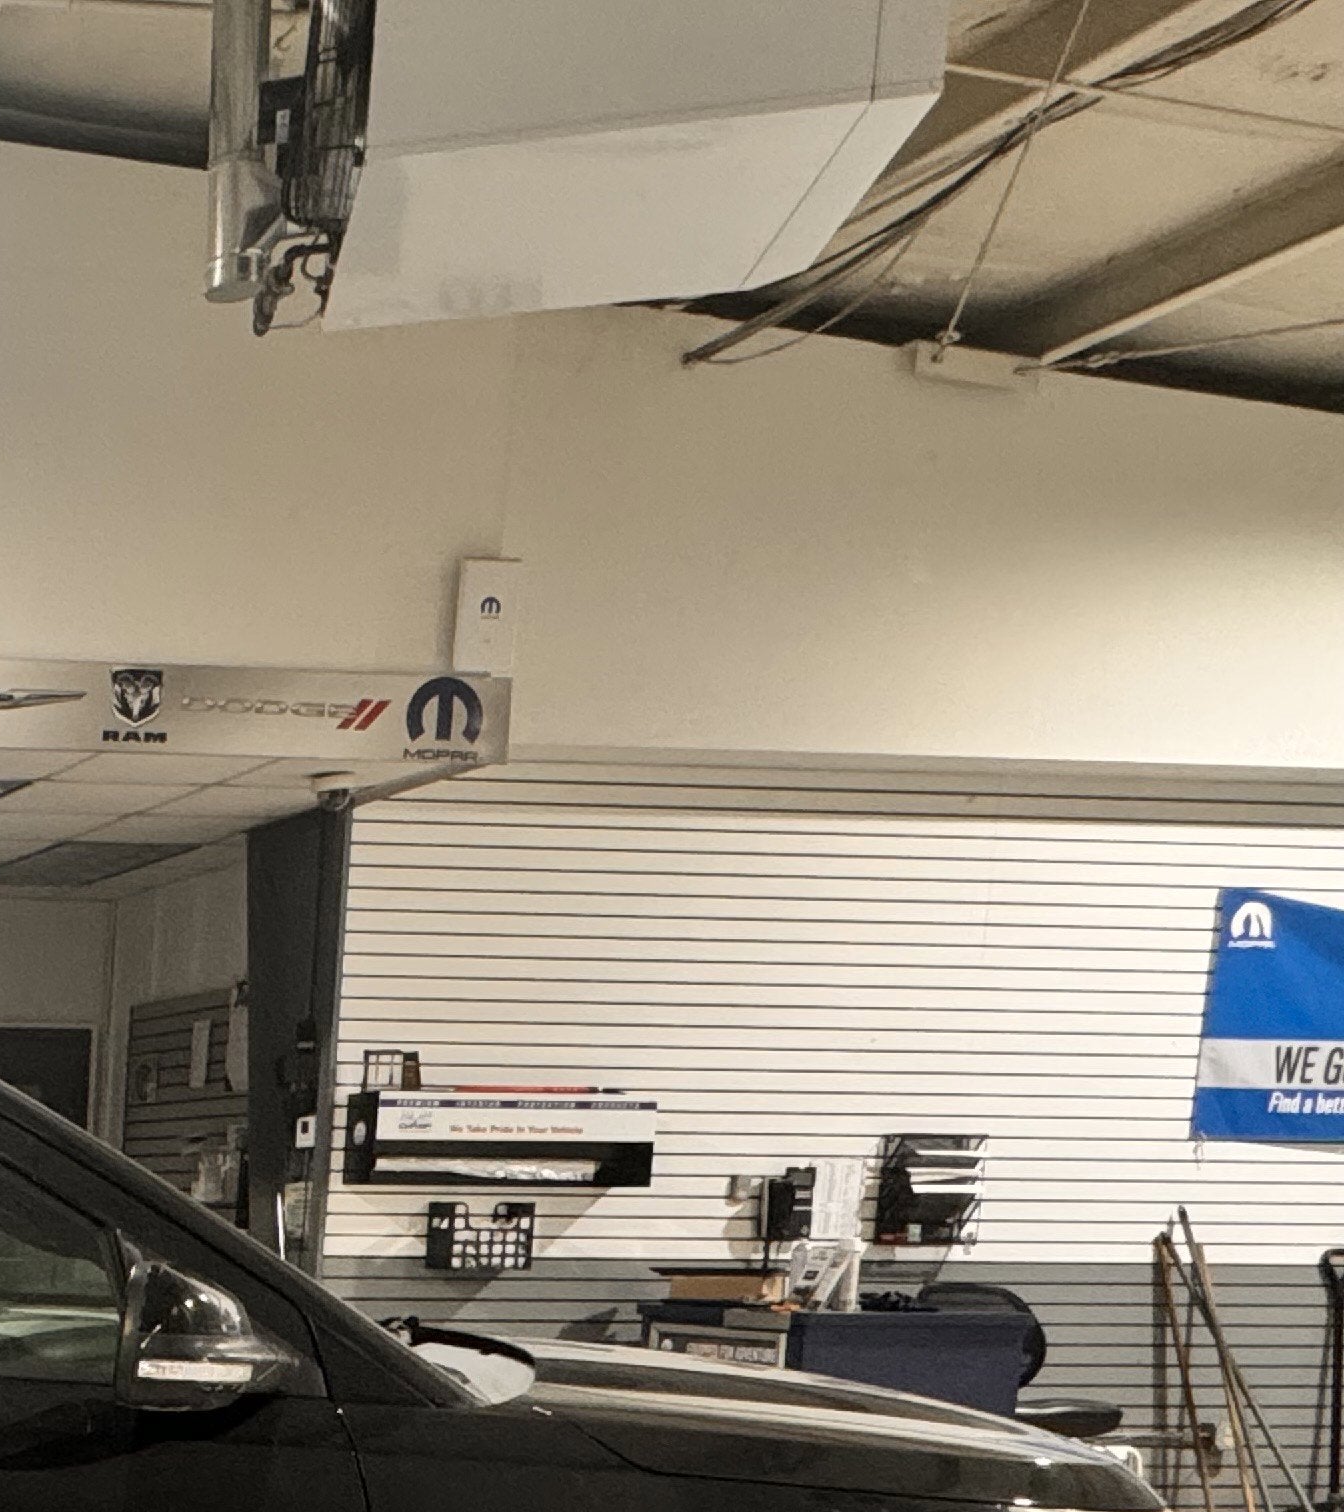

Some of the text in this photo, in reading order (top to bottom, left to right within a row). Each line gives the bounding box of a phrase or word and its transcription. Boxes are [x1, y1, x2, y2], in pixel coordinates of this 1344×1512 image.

[182, 698, 358, 718] DODGE
[101, 730, 168, 744] RAM
[402, 748, 477, 762] MOPAR
[1275, 1045, 1344, 1086] WE G
